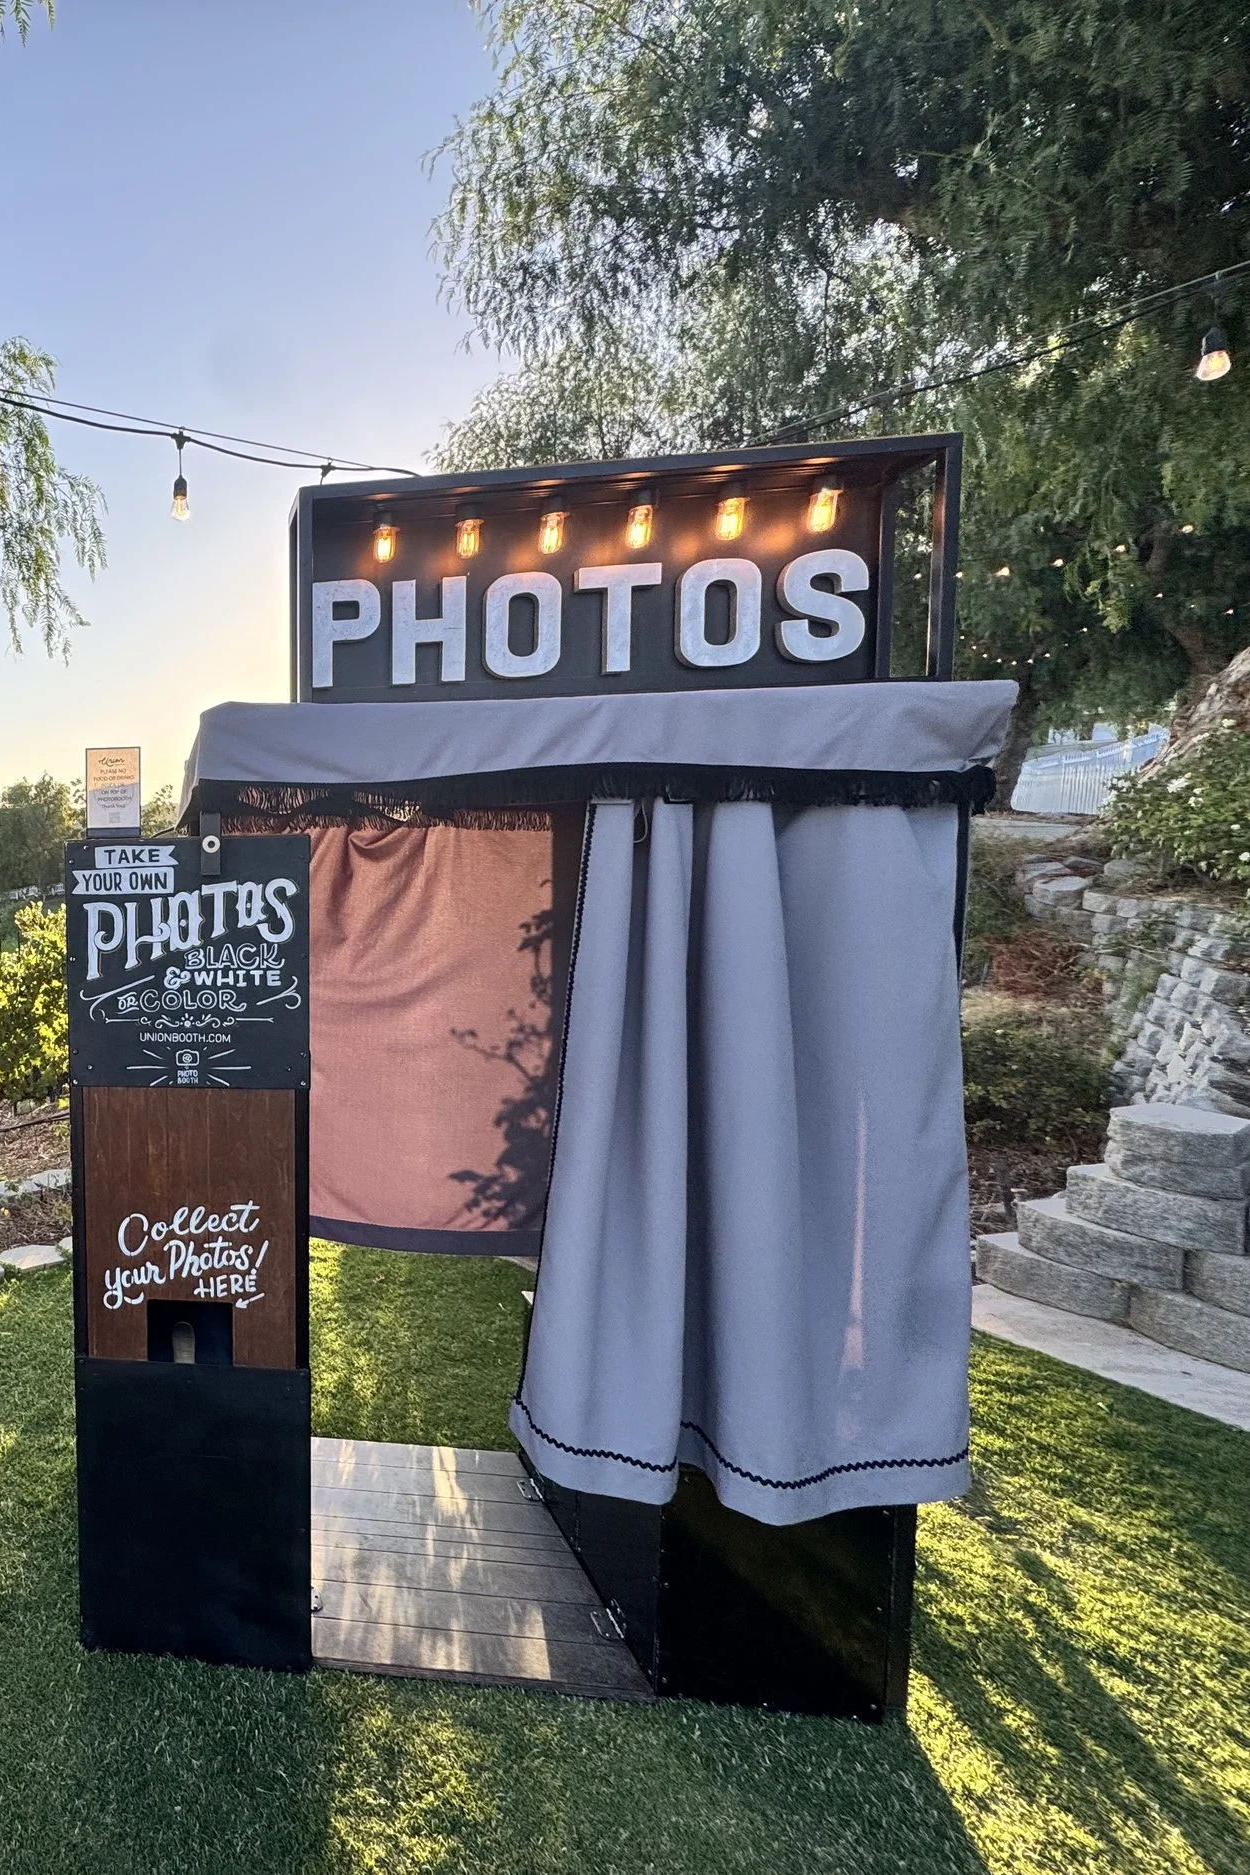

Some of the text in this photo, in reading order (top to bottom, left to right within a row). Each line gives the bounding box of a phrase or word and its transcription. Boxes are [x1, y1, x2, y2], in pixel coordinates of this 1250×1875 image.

[312, 548, 870, 689] PHOTOS
[104, 849, 160, 865] TAKE
[82, 871, 168, 892] YOUR OWN
[83, 878, 298, 981] PHOTOS
[184, 943, 286, 970] BLACK
[194, 970, 282, 987] WHITE
[117, 989, 247, 1014] OR COLOR
[139, 1032, 231, 1043] UNIONBOOTH.COM
[117, 1200, 260, 1257] Collect
[103, 1235, 269, 1310] your Photos!
[193, 1274, 258, 1299] HERE
